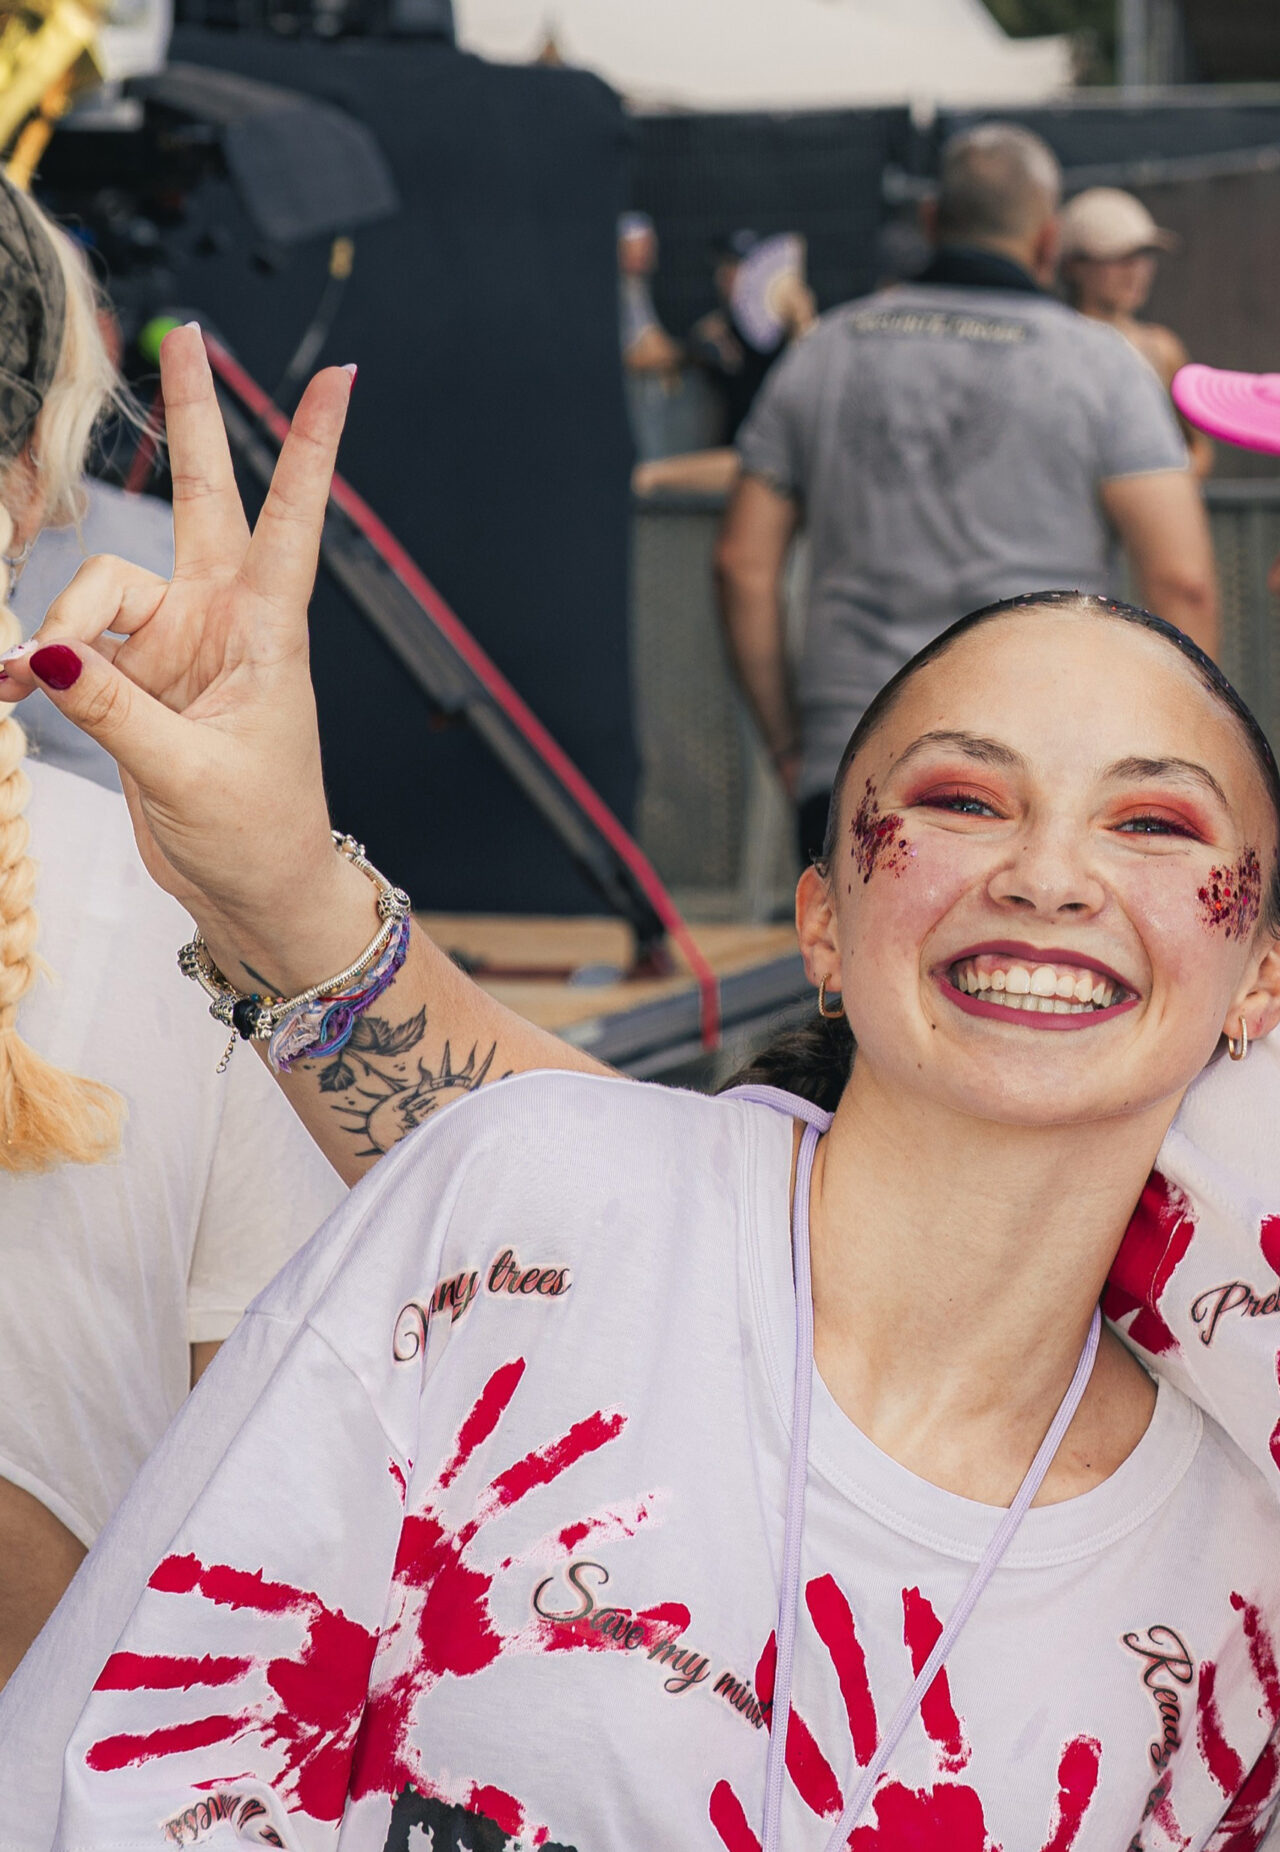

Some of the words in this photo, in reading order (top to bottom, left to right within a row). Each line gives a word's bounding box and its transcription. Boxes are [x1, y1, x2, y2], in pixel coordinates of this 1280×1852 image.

[488, 1249, 573, 1296] trees
[532, 1561, 646, 1650] Save
[646, 1639, 711, 1694] my
